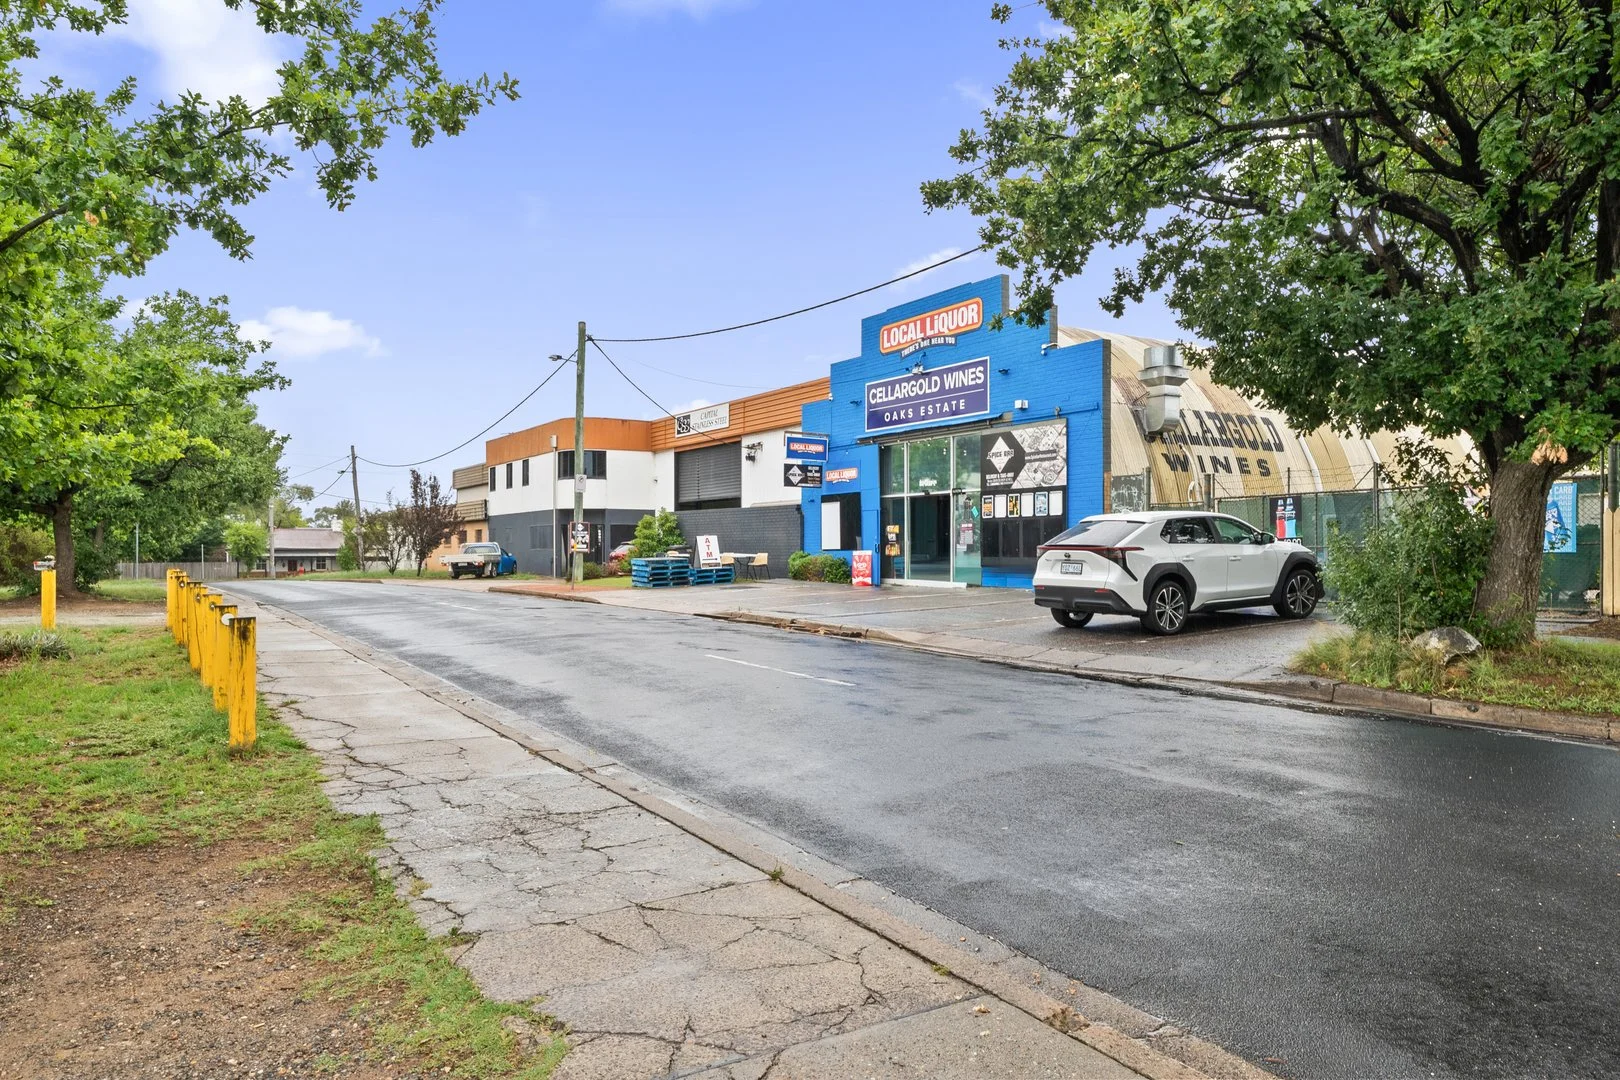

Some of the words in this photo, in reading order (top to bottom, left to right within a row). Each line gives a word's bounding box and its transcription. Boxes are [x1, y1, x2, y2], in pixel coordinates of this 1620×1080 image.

[883, 320, 924, 348] LOCAL
[901, 342, 919, 357] THERE'S
[931, 337, 944, 345] NEAR
[945, 336, 955, 344] YOU
[869, 375, 940, 404] CELLARGOLD
[943, 366, 984, 390] WINES
[701, 409, 718, 420] CAPITAL
[884, 408, 913, 422] OAKS
[920, 399, 965, 416] ESTATE
[692, 418, 714, 430] STAINLESS
[715, 416, 727, 425] STEEL
[987, 451, 1002, 459] SPICE
[1161, 453, 1271, 477] WINES
[826, 470, 840, 480] LOCAL
